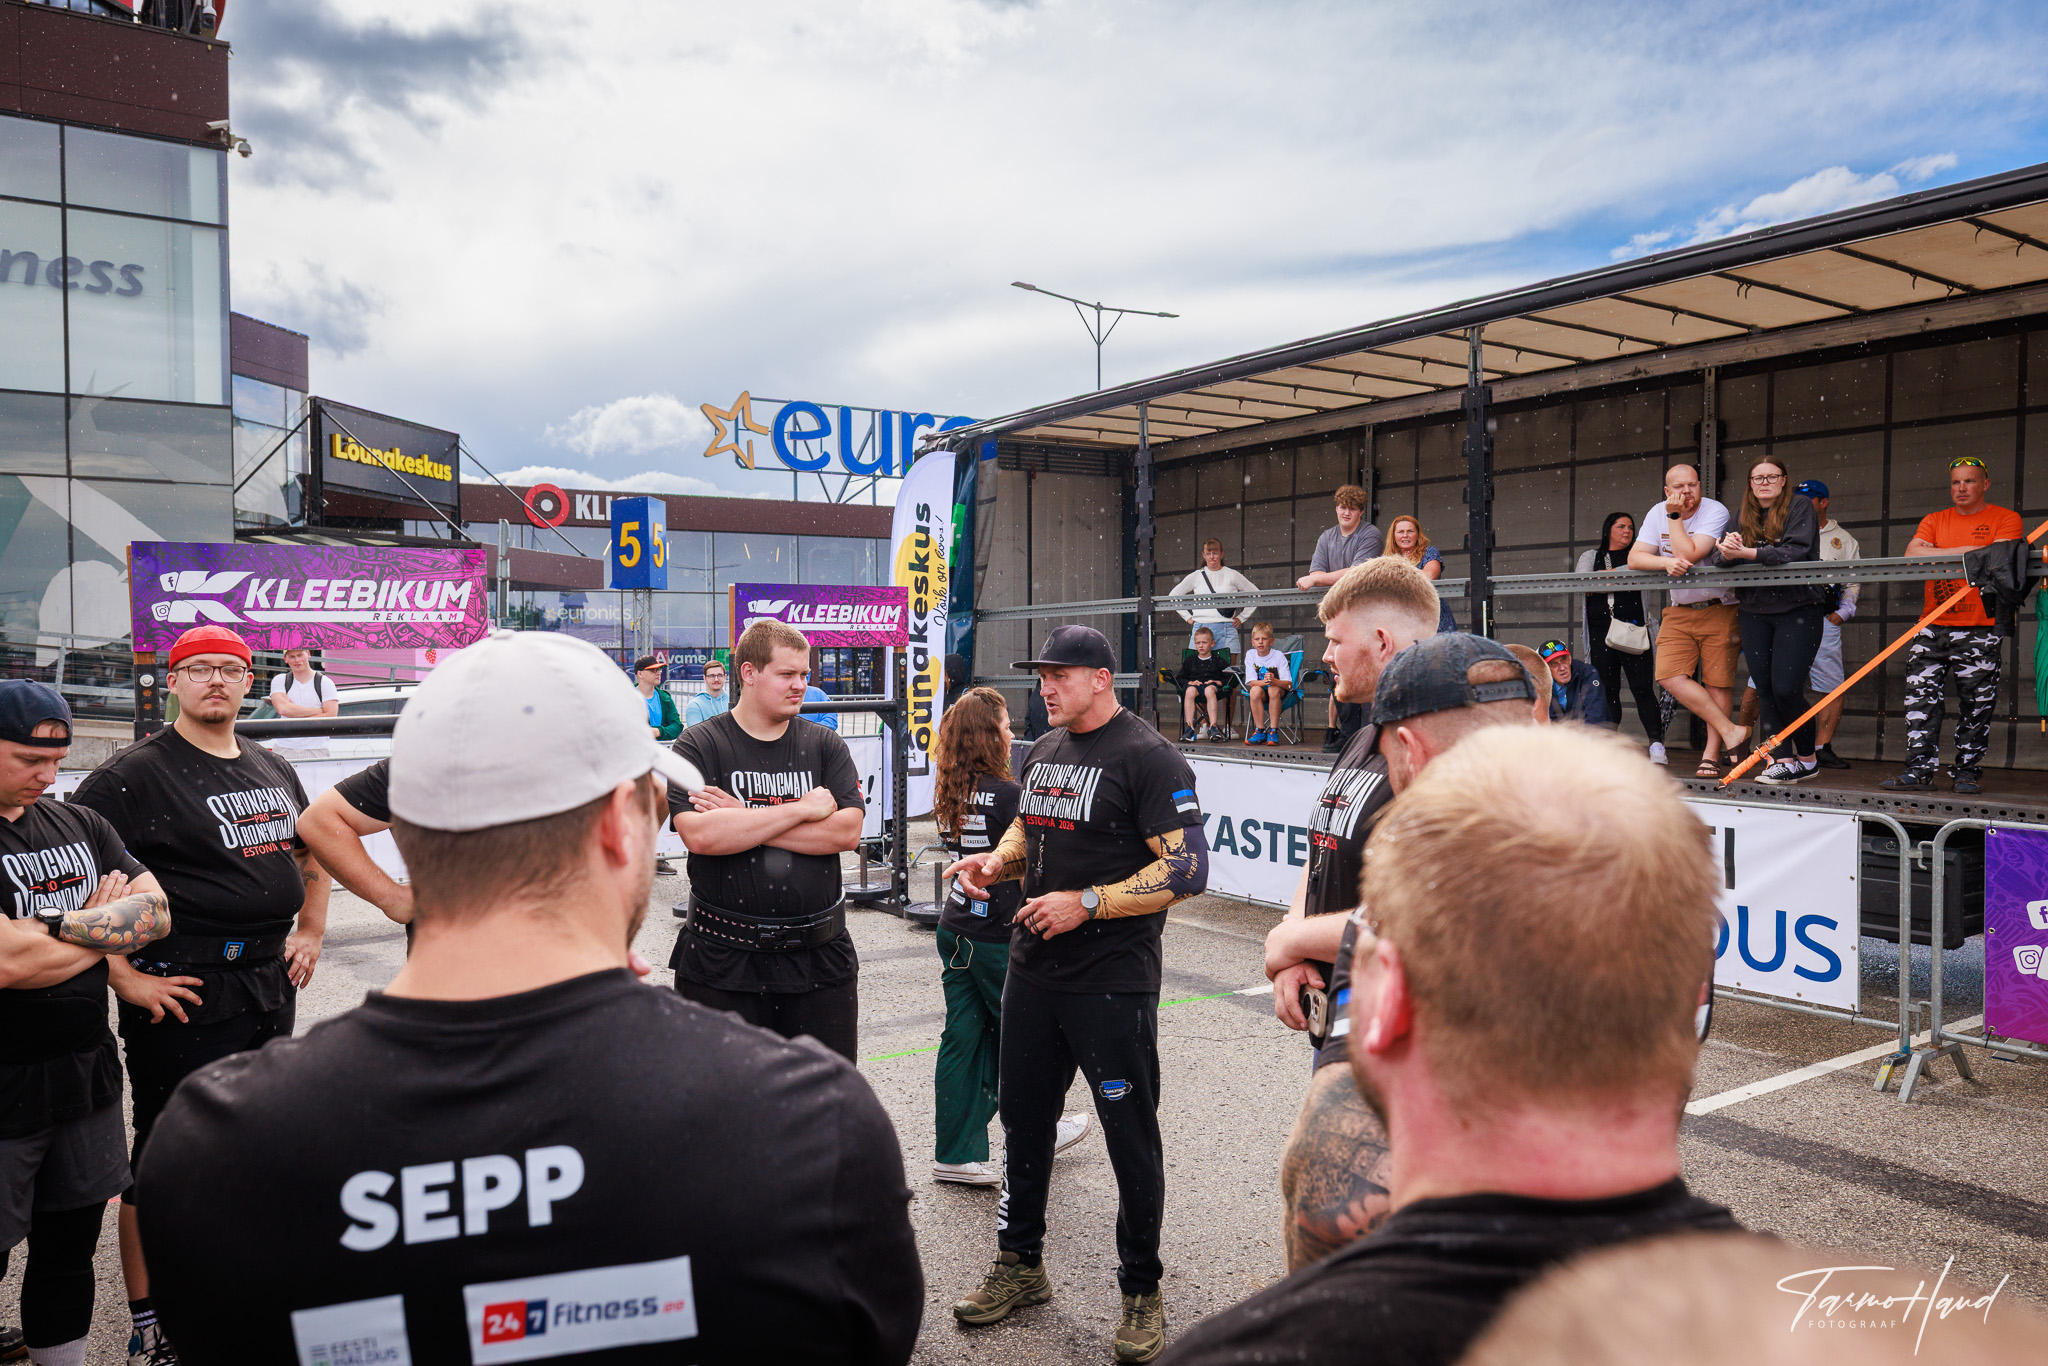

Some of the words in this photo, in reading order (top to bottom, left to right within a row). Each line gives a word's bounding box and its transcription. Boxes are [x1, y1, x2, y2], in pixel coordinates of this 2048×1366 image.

[0, 249, 145, 297] ness
[771, 400, 980, 478] eur
[331, 433, 453, 482] Lõunakeskus
[575, 494, 635, 521] KLI
[619, 521, 641, 568] 5
[653, 522, 665, 568] 5
[244, 578, 472, 610] KLEEBIKUM
[373, 612, 458, 621] REKLAAM
[557, 605, 632, 621] euronics
[787, 604, 902, 623] KLEEBIKUM
[655, 651, 707, 665] Avame
[1048, 788, 1062, 797] PRO
[253, 813, 270, 824] PRO
[1058, 819, 1075, 831] 2026
[339, 1144, 586, 1252] SEPP
[486, 1311, 522, 1337] 24
[528, 1308, 546, 1332] 7
